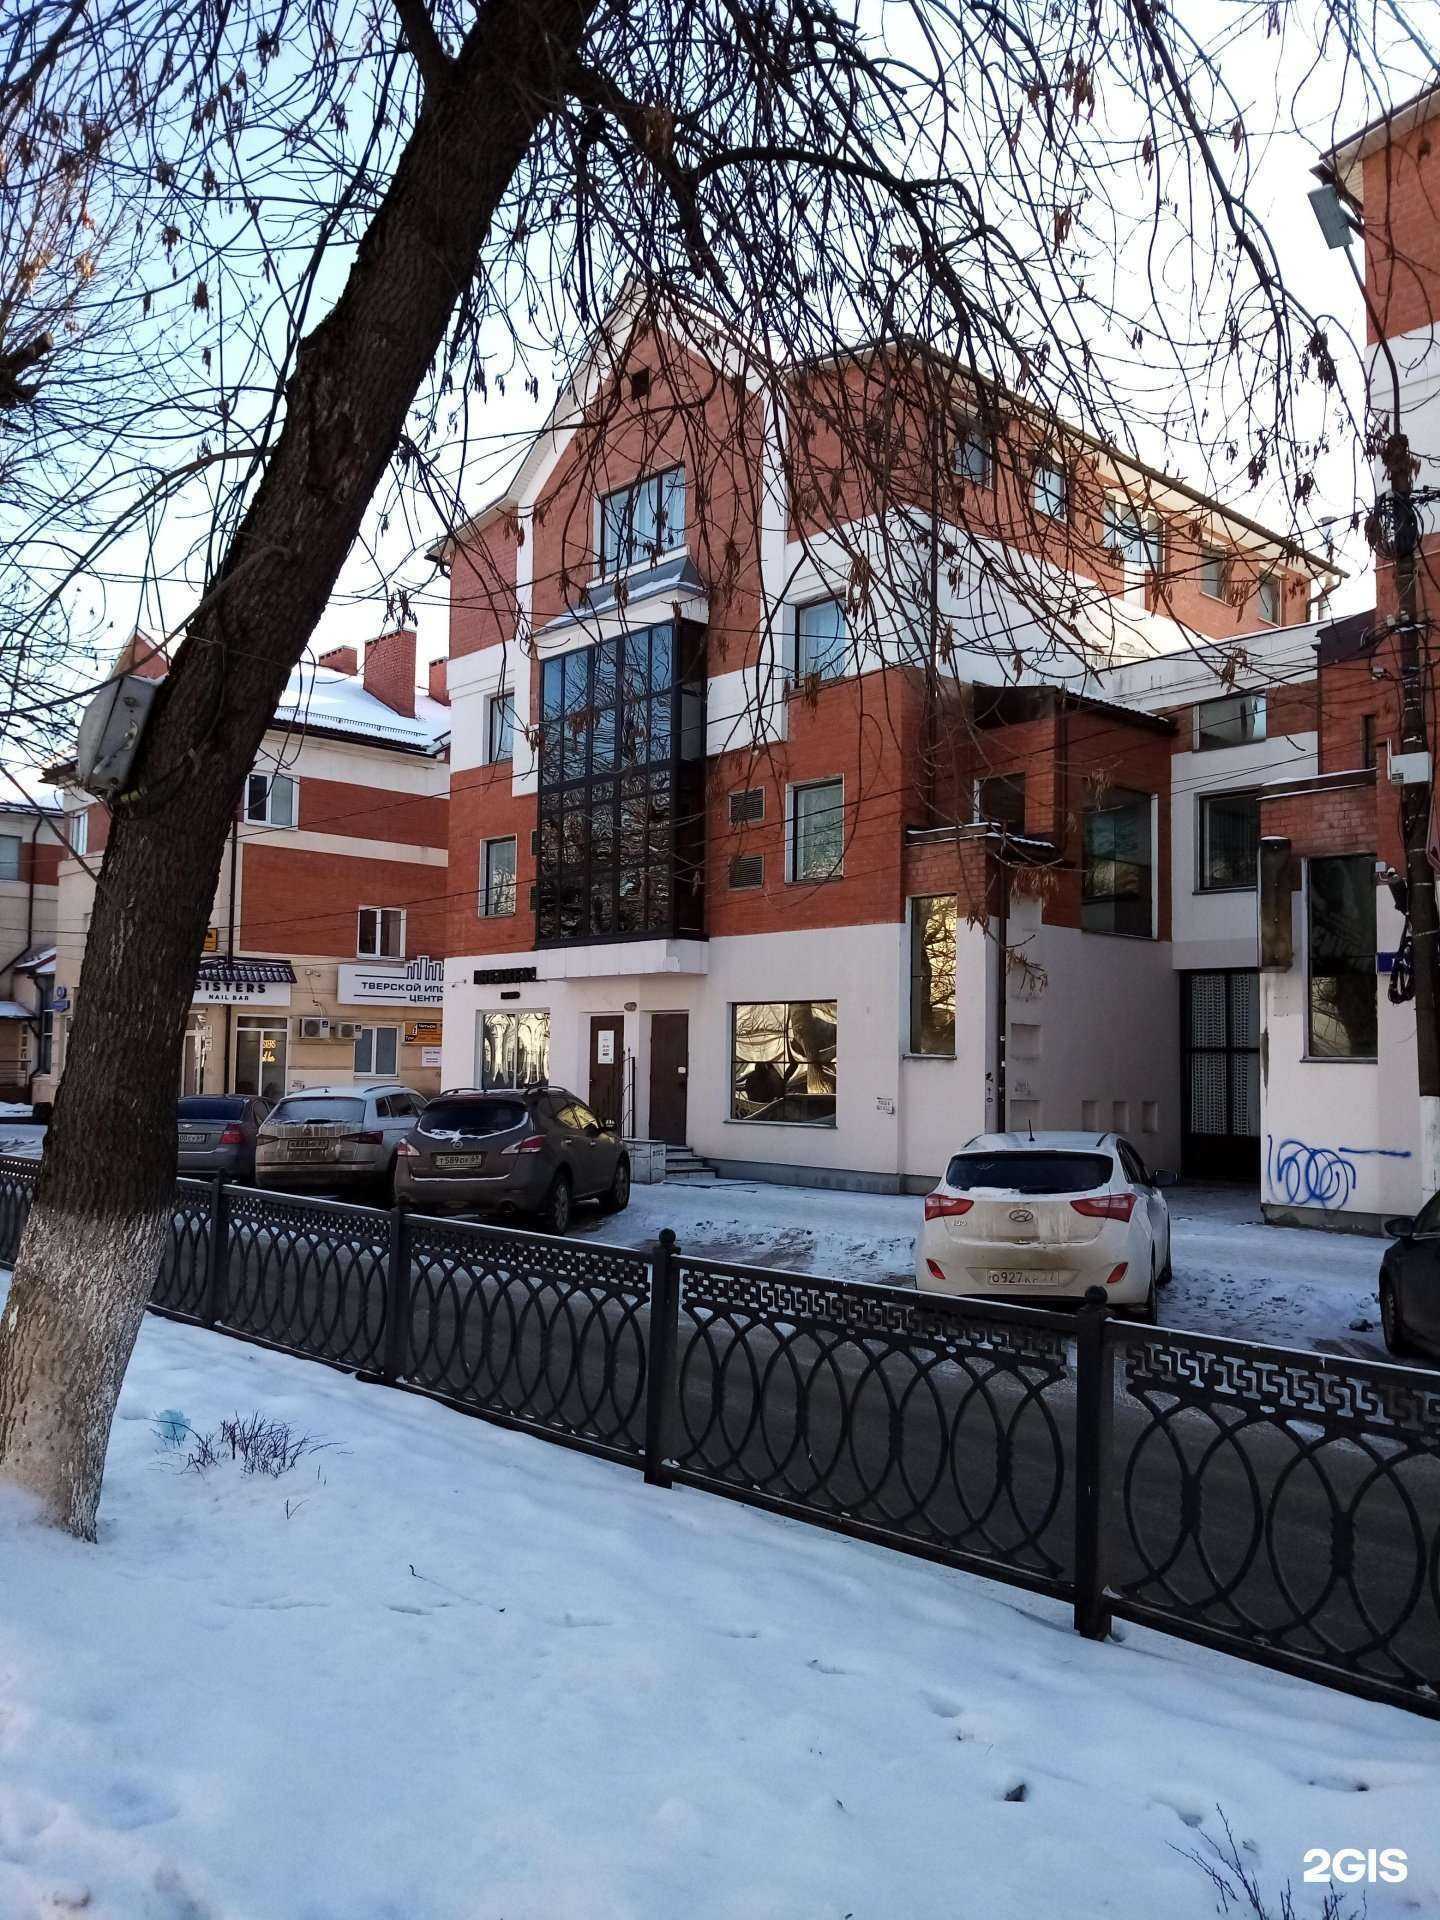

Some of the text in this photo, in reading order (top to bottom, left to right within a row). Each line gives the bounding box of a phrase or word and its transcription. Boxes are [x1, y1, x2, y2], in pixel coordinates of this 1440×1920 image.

[193, 981, 266, 993] SISTERS
[361, 981, 421, 992] ТВЕРСКОЙ
[409, 994, 444, 1003] ЦЕНТР
